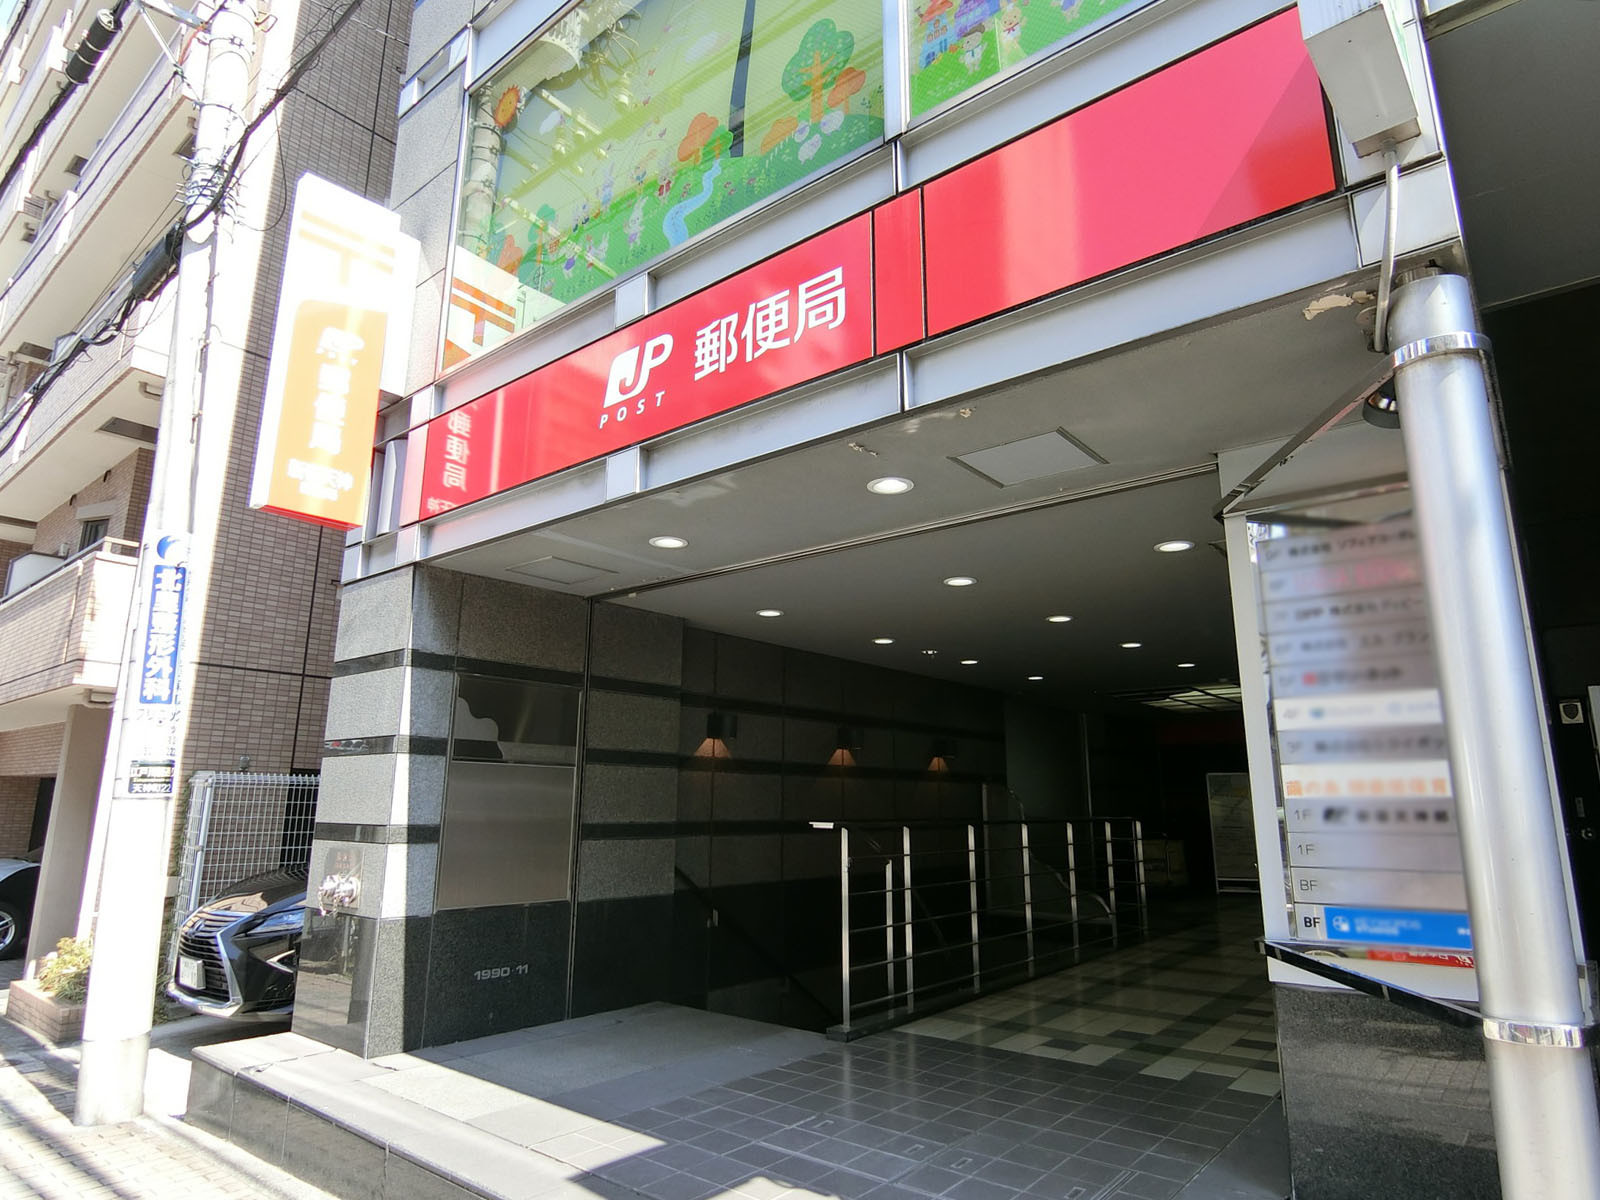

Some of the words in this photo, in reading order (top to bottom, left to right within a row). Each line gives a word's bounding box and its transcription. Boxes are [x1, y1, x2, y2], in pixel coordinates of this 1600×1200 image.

[693, 266, 847, 381] 郵便局
[599, 390, 667, 429] POST
[1294, 809, 1313, 821] 1F
[1297, 844, 1315, 855] 1F
[1299, 879, 1318, 891] BF
[1303, 917, 1320, 928] BF
